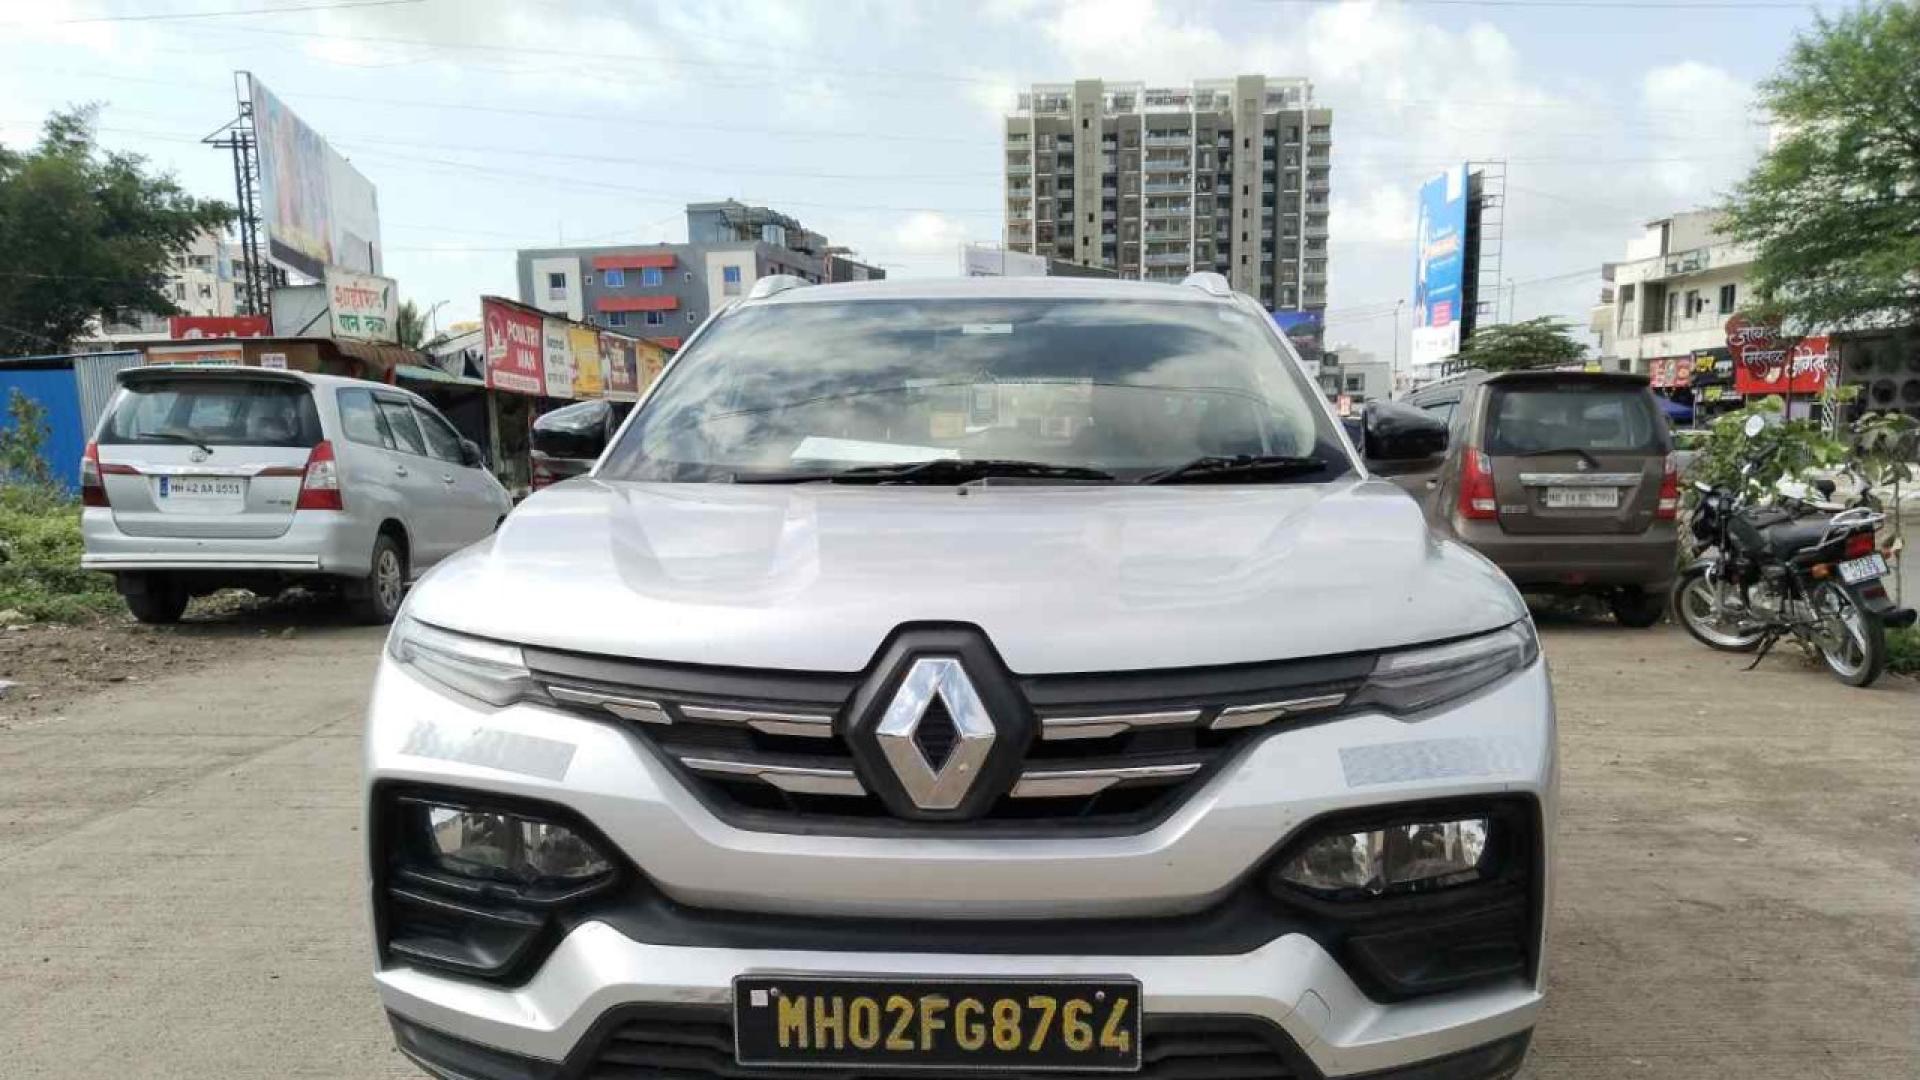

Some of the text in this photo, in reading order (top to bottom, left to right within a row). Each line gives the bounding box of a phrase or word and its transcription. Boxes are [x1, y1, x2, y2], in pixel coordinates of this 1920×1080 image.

[507, 319, 540, 346] POULTRY
[170, 483, 184, 494] MH
[777, 994, 1130, 1053] MH02FG8764
